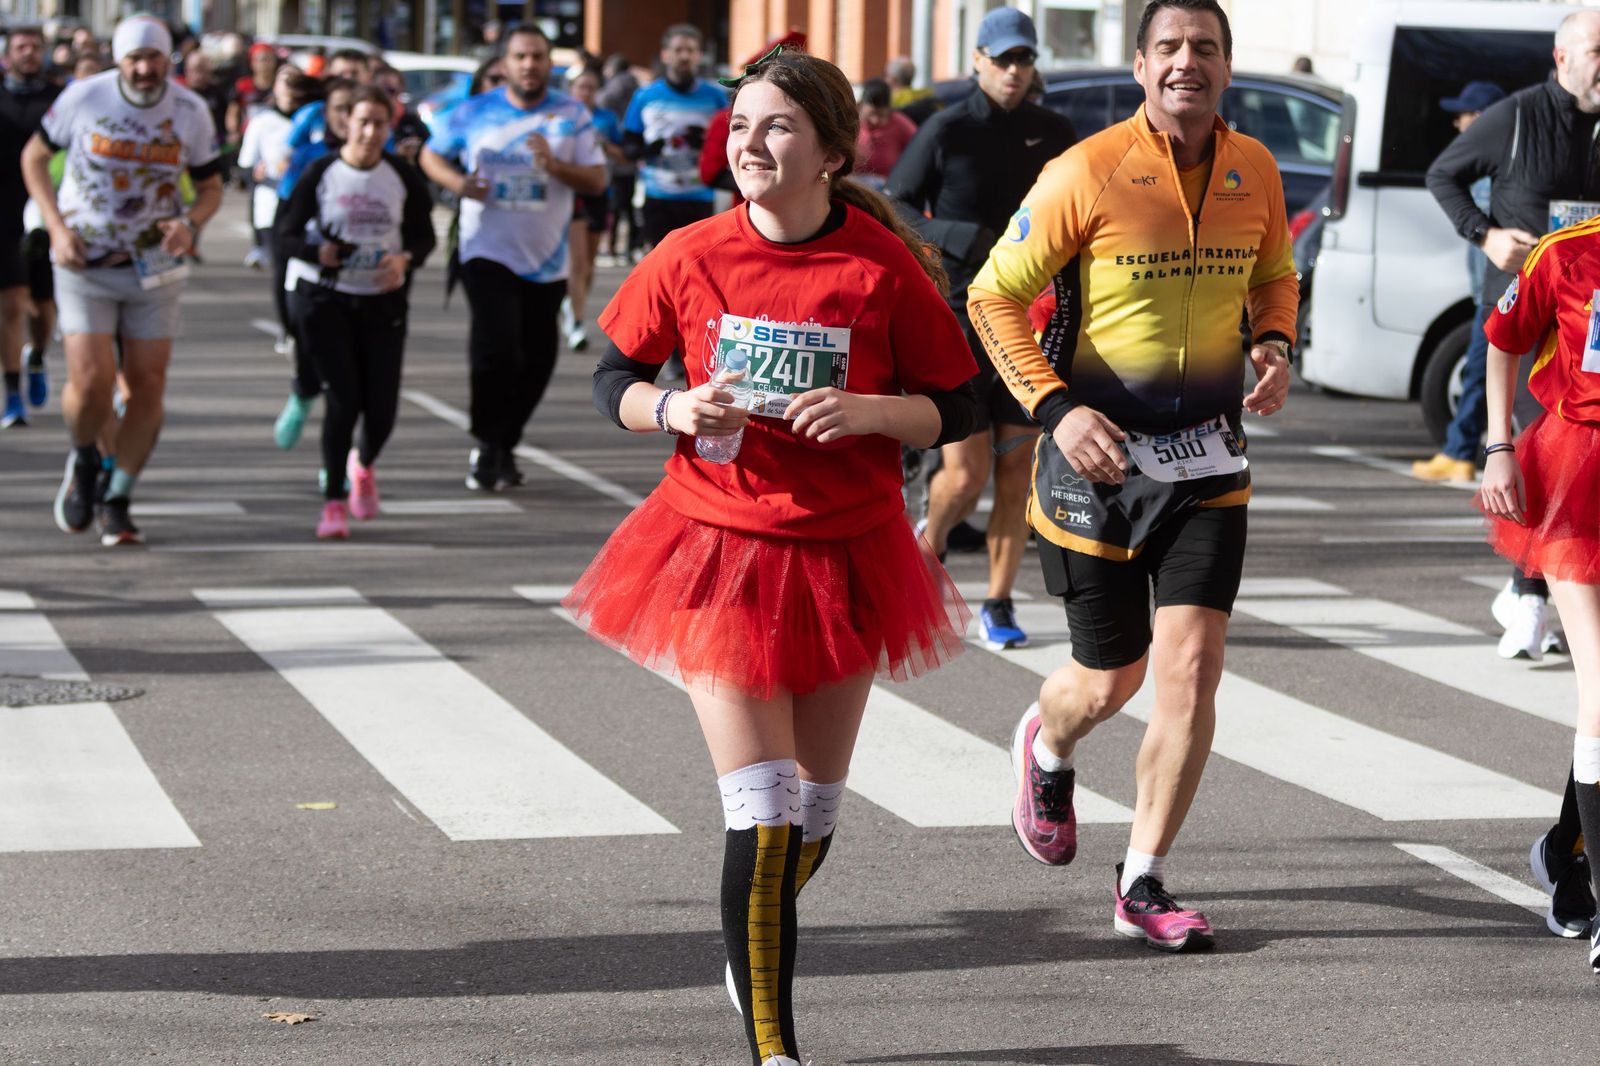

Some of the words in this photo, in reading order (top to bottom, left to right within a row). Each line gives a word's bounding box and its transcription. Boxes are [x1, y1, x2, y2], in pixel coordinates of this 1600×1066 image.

[1570, 206, 1600, 216] SET
[1116, 249, 1191, 265] ESCUELA
[1198, 246, 1257, 260] TRIATLÓ
[1132, 265, 1244, 280] SALMANTINA
[753, 325, 836, 348] SETEL
[975, 303, 999, 347] ESCUELA
[999, 347, 1036, 394] TRIATLÓN
[758, 384, 784, 394] CELTA
[1154, 422, 1217, 445] SETEL
[1152, 440, 1207, 465] 500
[1051, 489, 1091, 504] HERRERO
